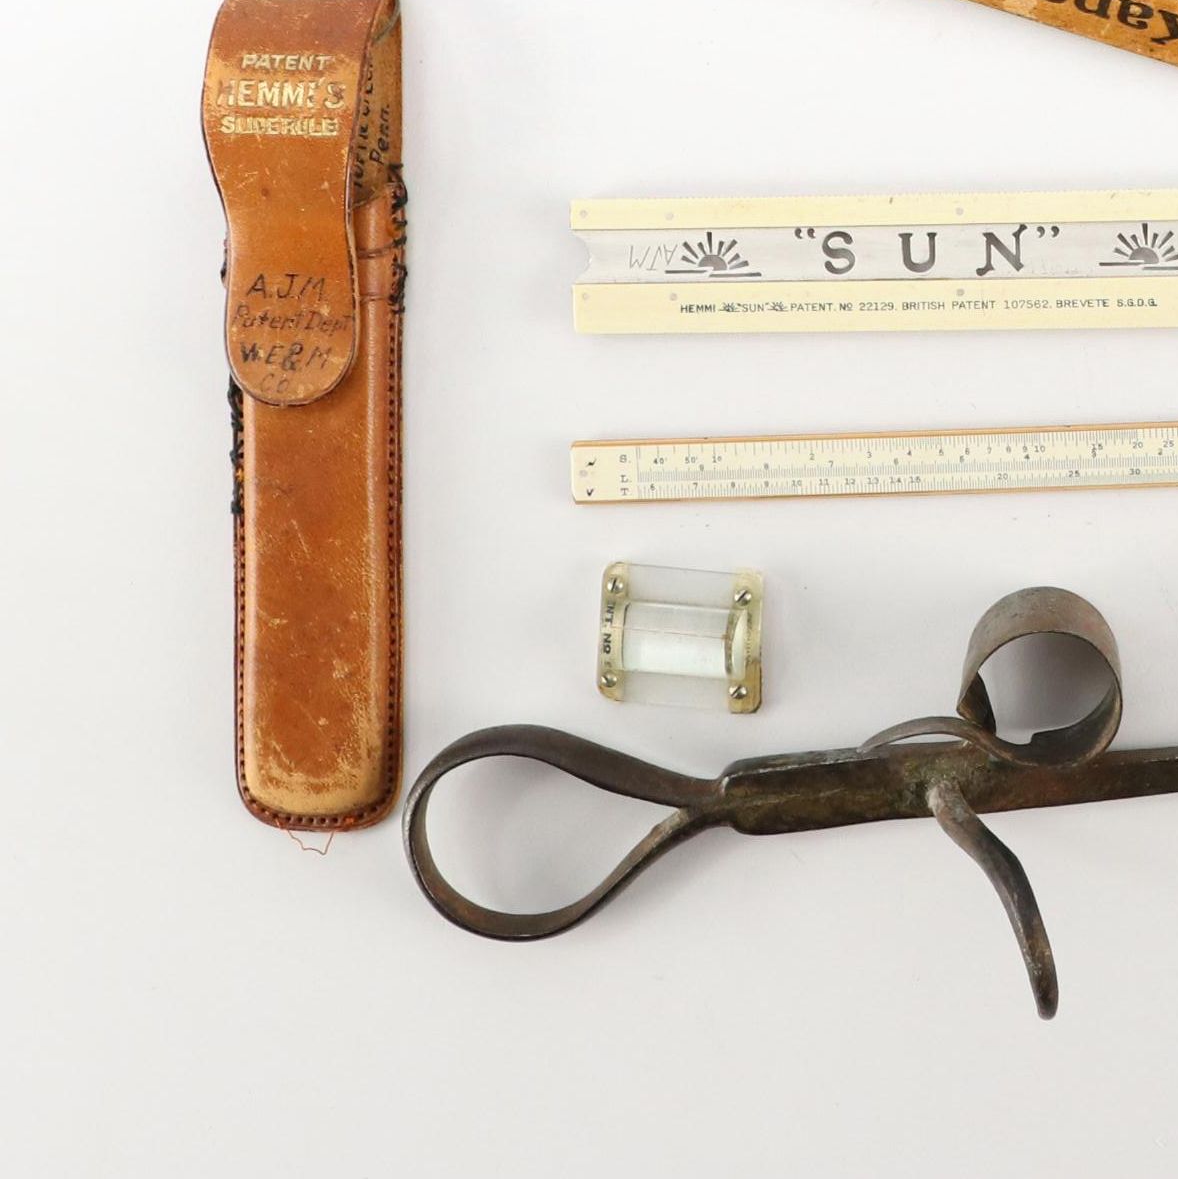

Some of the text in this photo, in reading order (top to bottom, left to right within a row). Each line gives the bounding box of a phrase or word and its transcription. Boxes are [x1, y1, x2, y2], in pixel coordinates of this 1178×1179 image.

[241, 53, 336, 71] PATENT
[369, 104, 390, 165] Penn.
[680, 303, 716, 313] HEMMI
[790, 302, 836, 312] PATENT.
[902, 300, 945, 311] BRITISH
[951, 300, 996, 310] PATENT
[1056, 299, 1109, 308] BREVETE
